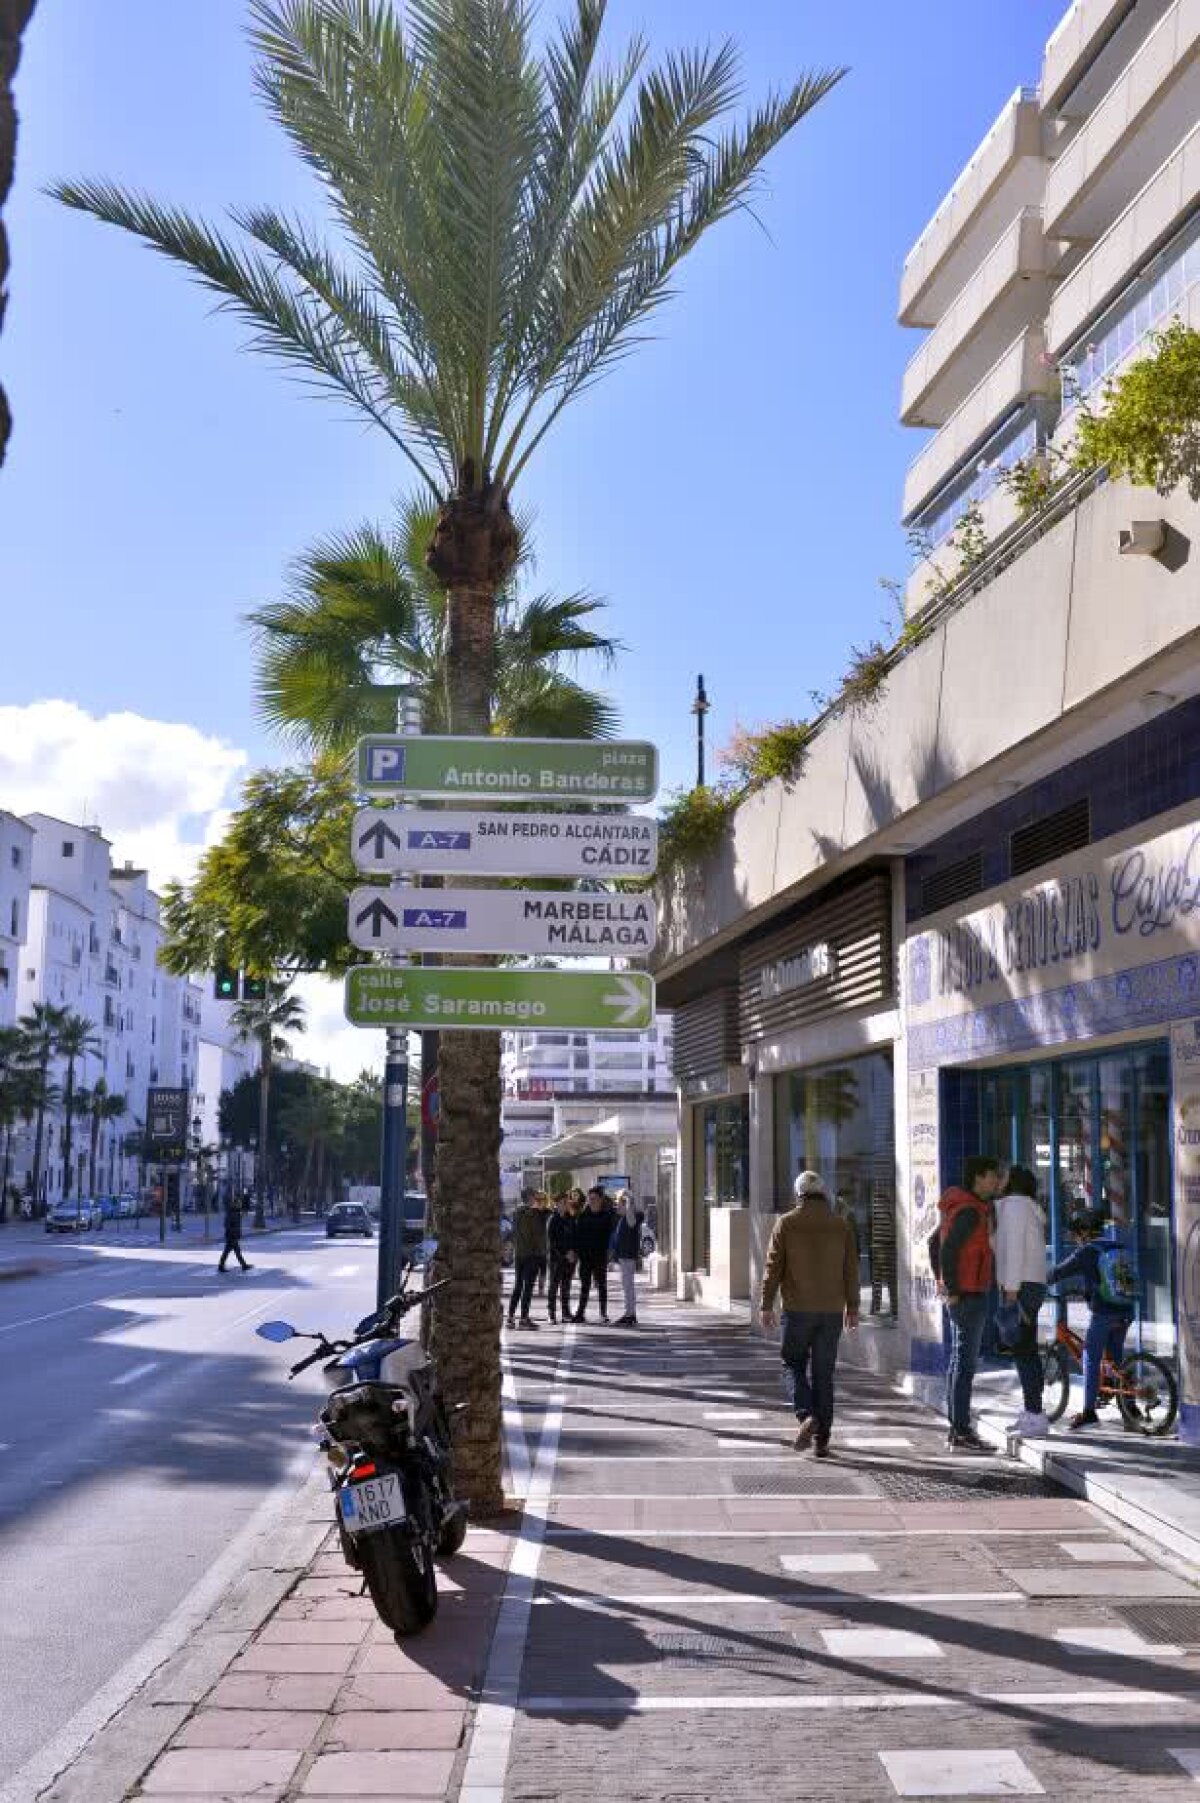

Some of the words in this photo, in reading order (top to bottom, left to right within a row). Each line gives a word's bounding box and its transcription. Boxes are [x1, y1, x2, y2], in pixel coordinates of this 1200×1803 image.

[603, 752, 647, 767] plaza
[444, 767, 532, 788] Antonio
[540, 770, 647, 790] Banderas
[420, 832, 459, 847] A-7
[477, 821, 509, 837] SAN
[512, 822, 559, 838] PEDRO
[565, 822, 650, 840] ALCÁNTARA
[581, 843, 650, 866] CÁDIZ
[416, 912, 455, 926] A-7
[523, 900, 649, 922] MARBELLA
[547, 922, 649, 945] MÁLAGA
[359, 973, 404, 989] calle
[359, 993, 412, 1013] José
[423, 996, 547, 1019] Saramago
